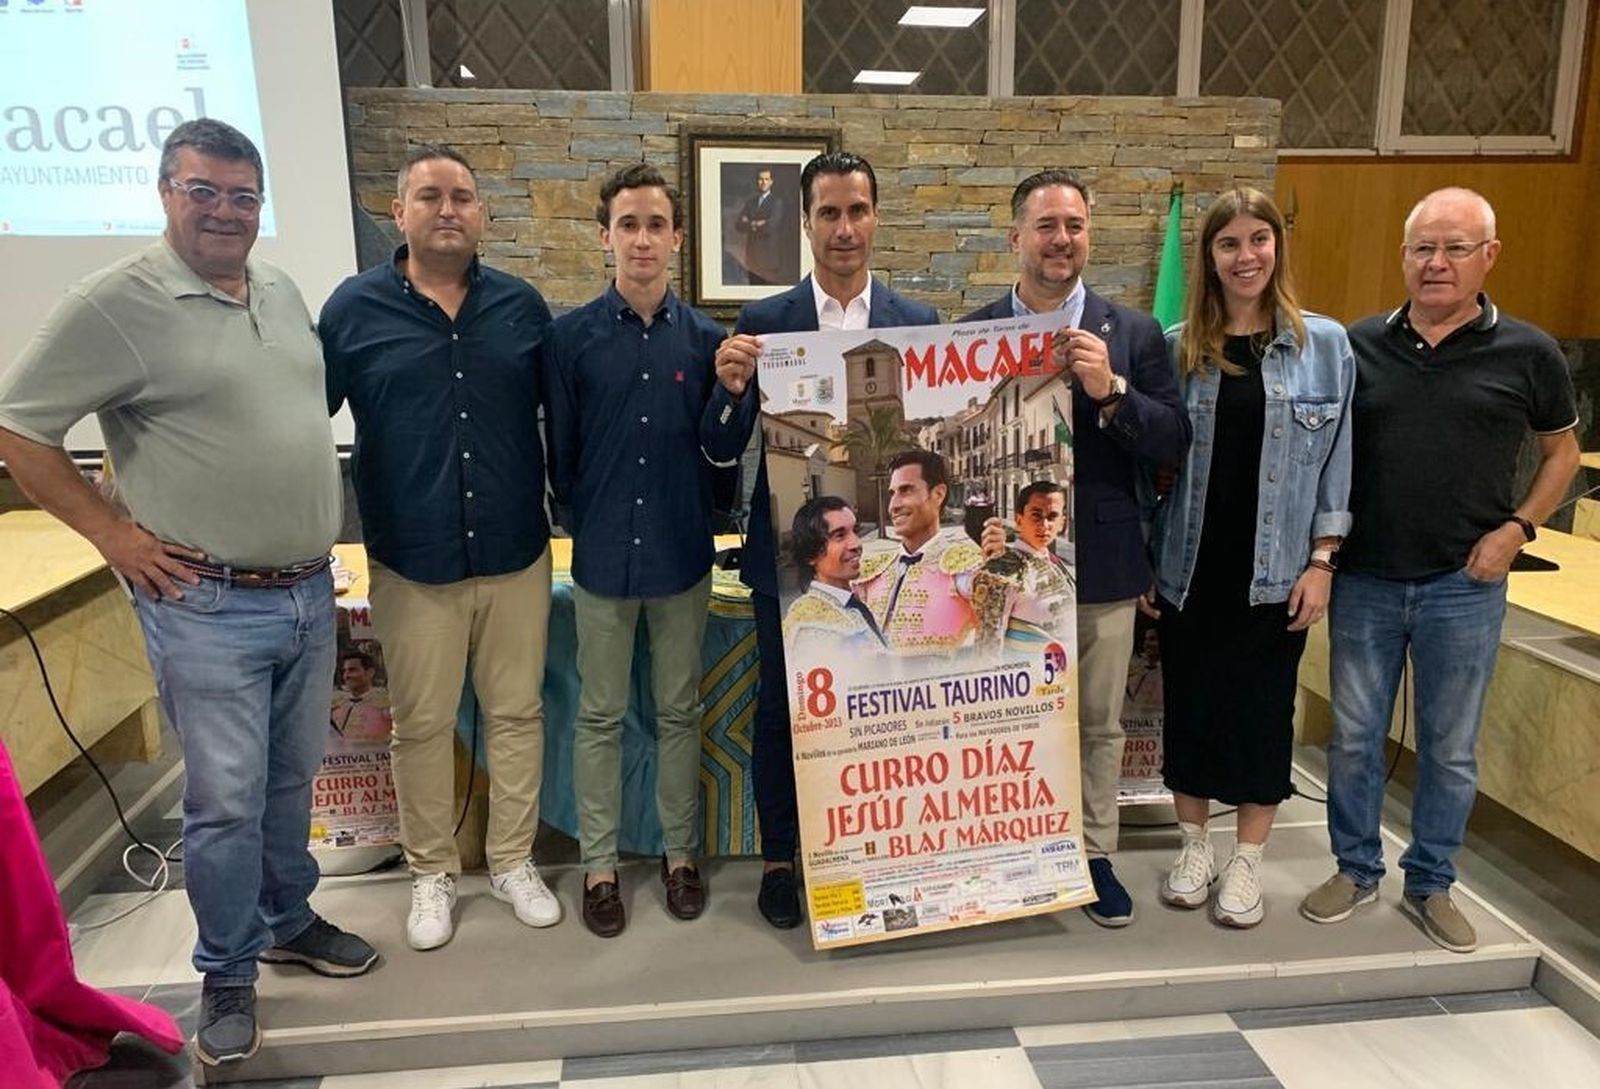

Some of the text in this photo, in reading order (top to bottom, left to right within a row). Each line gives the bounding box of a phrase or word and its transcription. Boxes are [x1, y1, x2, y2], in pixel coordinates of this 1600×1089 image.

[1, 165, 149, 186] AYUNTAMIENTO
[905, 331, 1063, 391] MACAEL
[796, 671, 807, 721] Domingo
[806, 667, 837, 719] 8
[846, 670, 1032, 720] FESTIVAL TAURINO
[953, 711, 961, 725] 5
[963, 709, 1003, 724] BRAVOS
[1005, 700, 1055, 717] NOVILLOS
[1056, 696, 1065, 710] 5
[849, 719, 908, 739] SIN PICADORES
[1124, 740, 1157, 753] RRO
[322, 753, 371, 766] FESTIVAL
[840, 738, 1036, 797] CURRO DÍAZ
[316, 774, 378, 791] CURRO
[360, 788, 397, 804] ALM
[824, 772, 1057, 847] JESÚS ALMERÍA
[889, 811, 1071, 859] BLAS MÁRQUEZ
